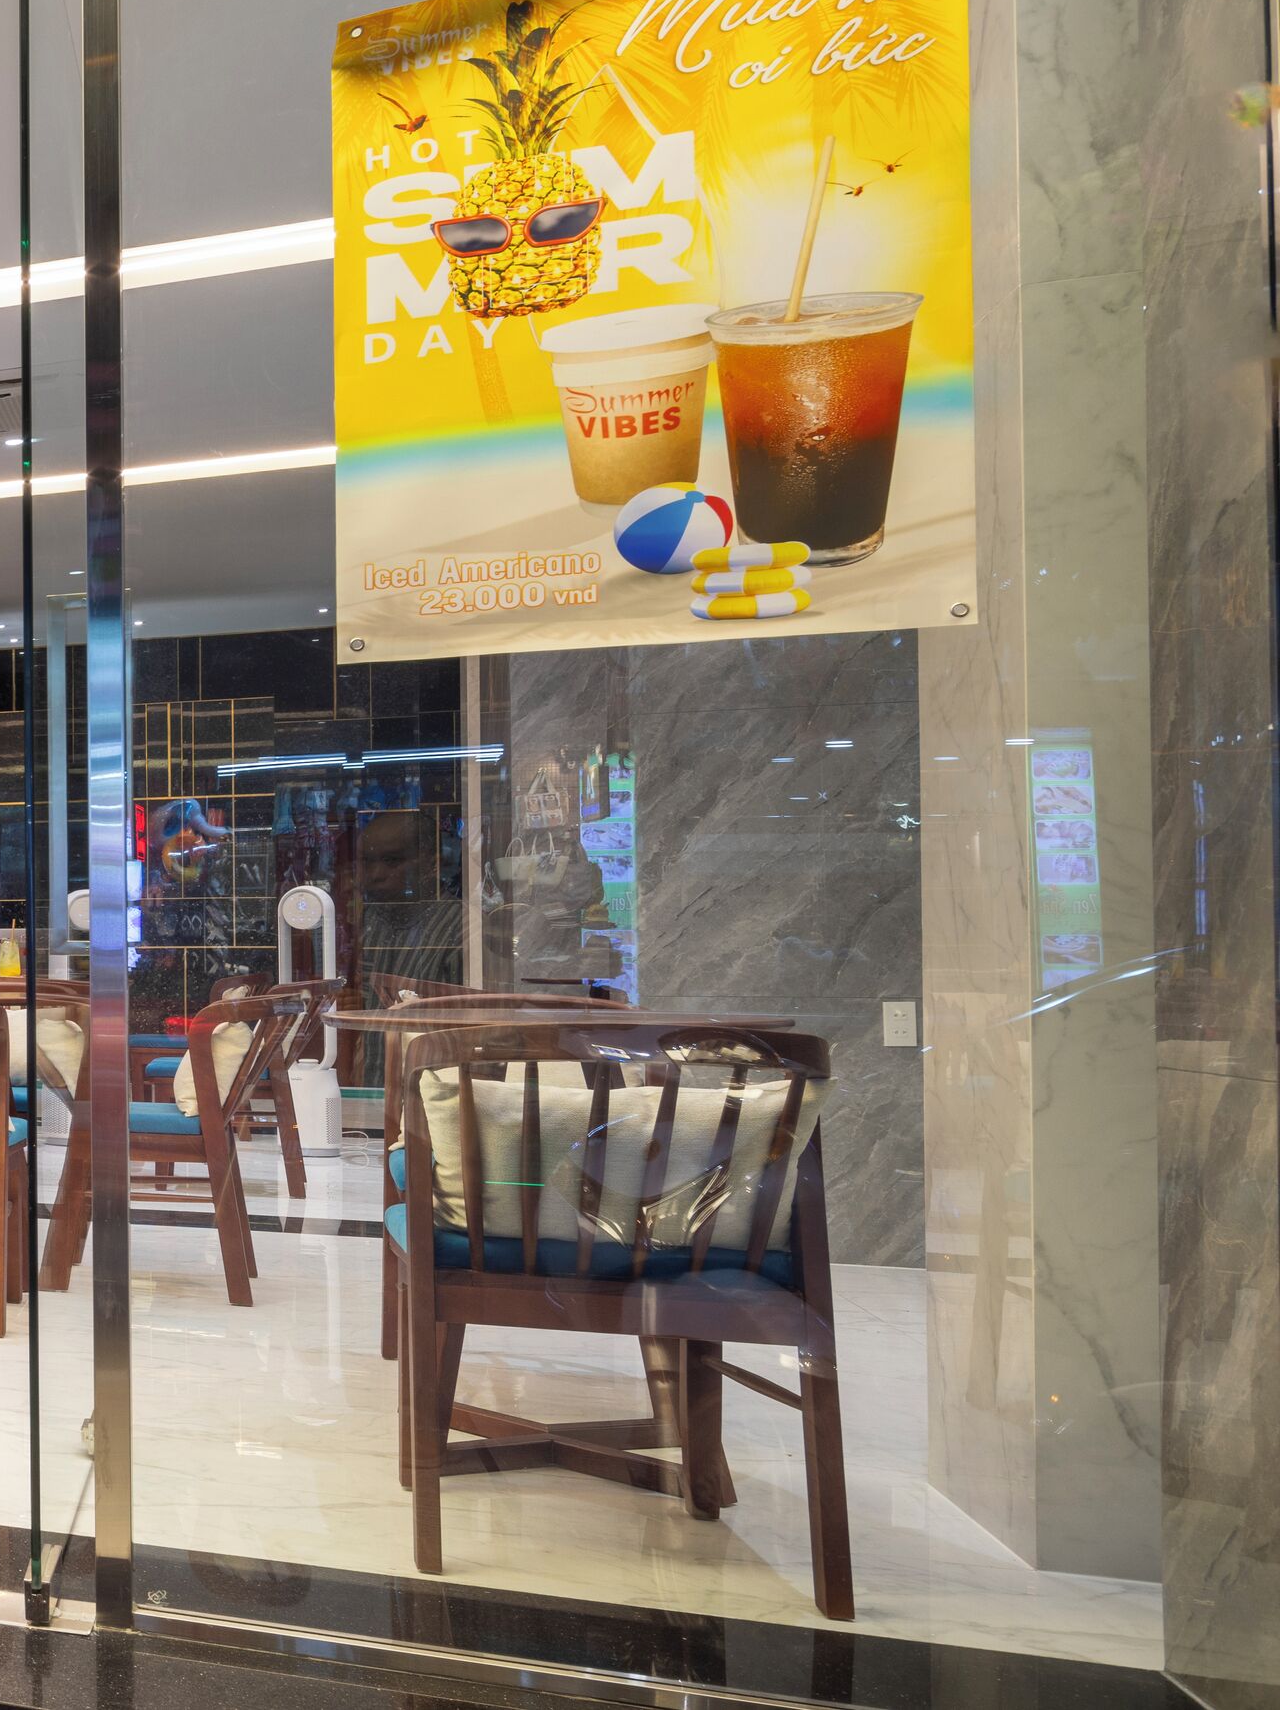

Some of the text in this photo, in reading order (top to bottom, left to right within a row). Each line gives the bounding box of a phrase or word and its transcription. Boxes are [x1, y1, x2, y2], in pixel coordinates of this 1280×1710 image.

[361, 22, 487, 62] Summer
[380, 47, 476, 77] VIBES
[365, 129, 480, 172] HOT
[364, 315, 505, 364] DAY
[565, 381, 695, 414] Summer
[577, 406, 681, 439] VIBES
[364, 551, 602, 590] Iced Americano
[419, 582, 598, 616] 23.000 vnd
